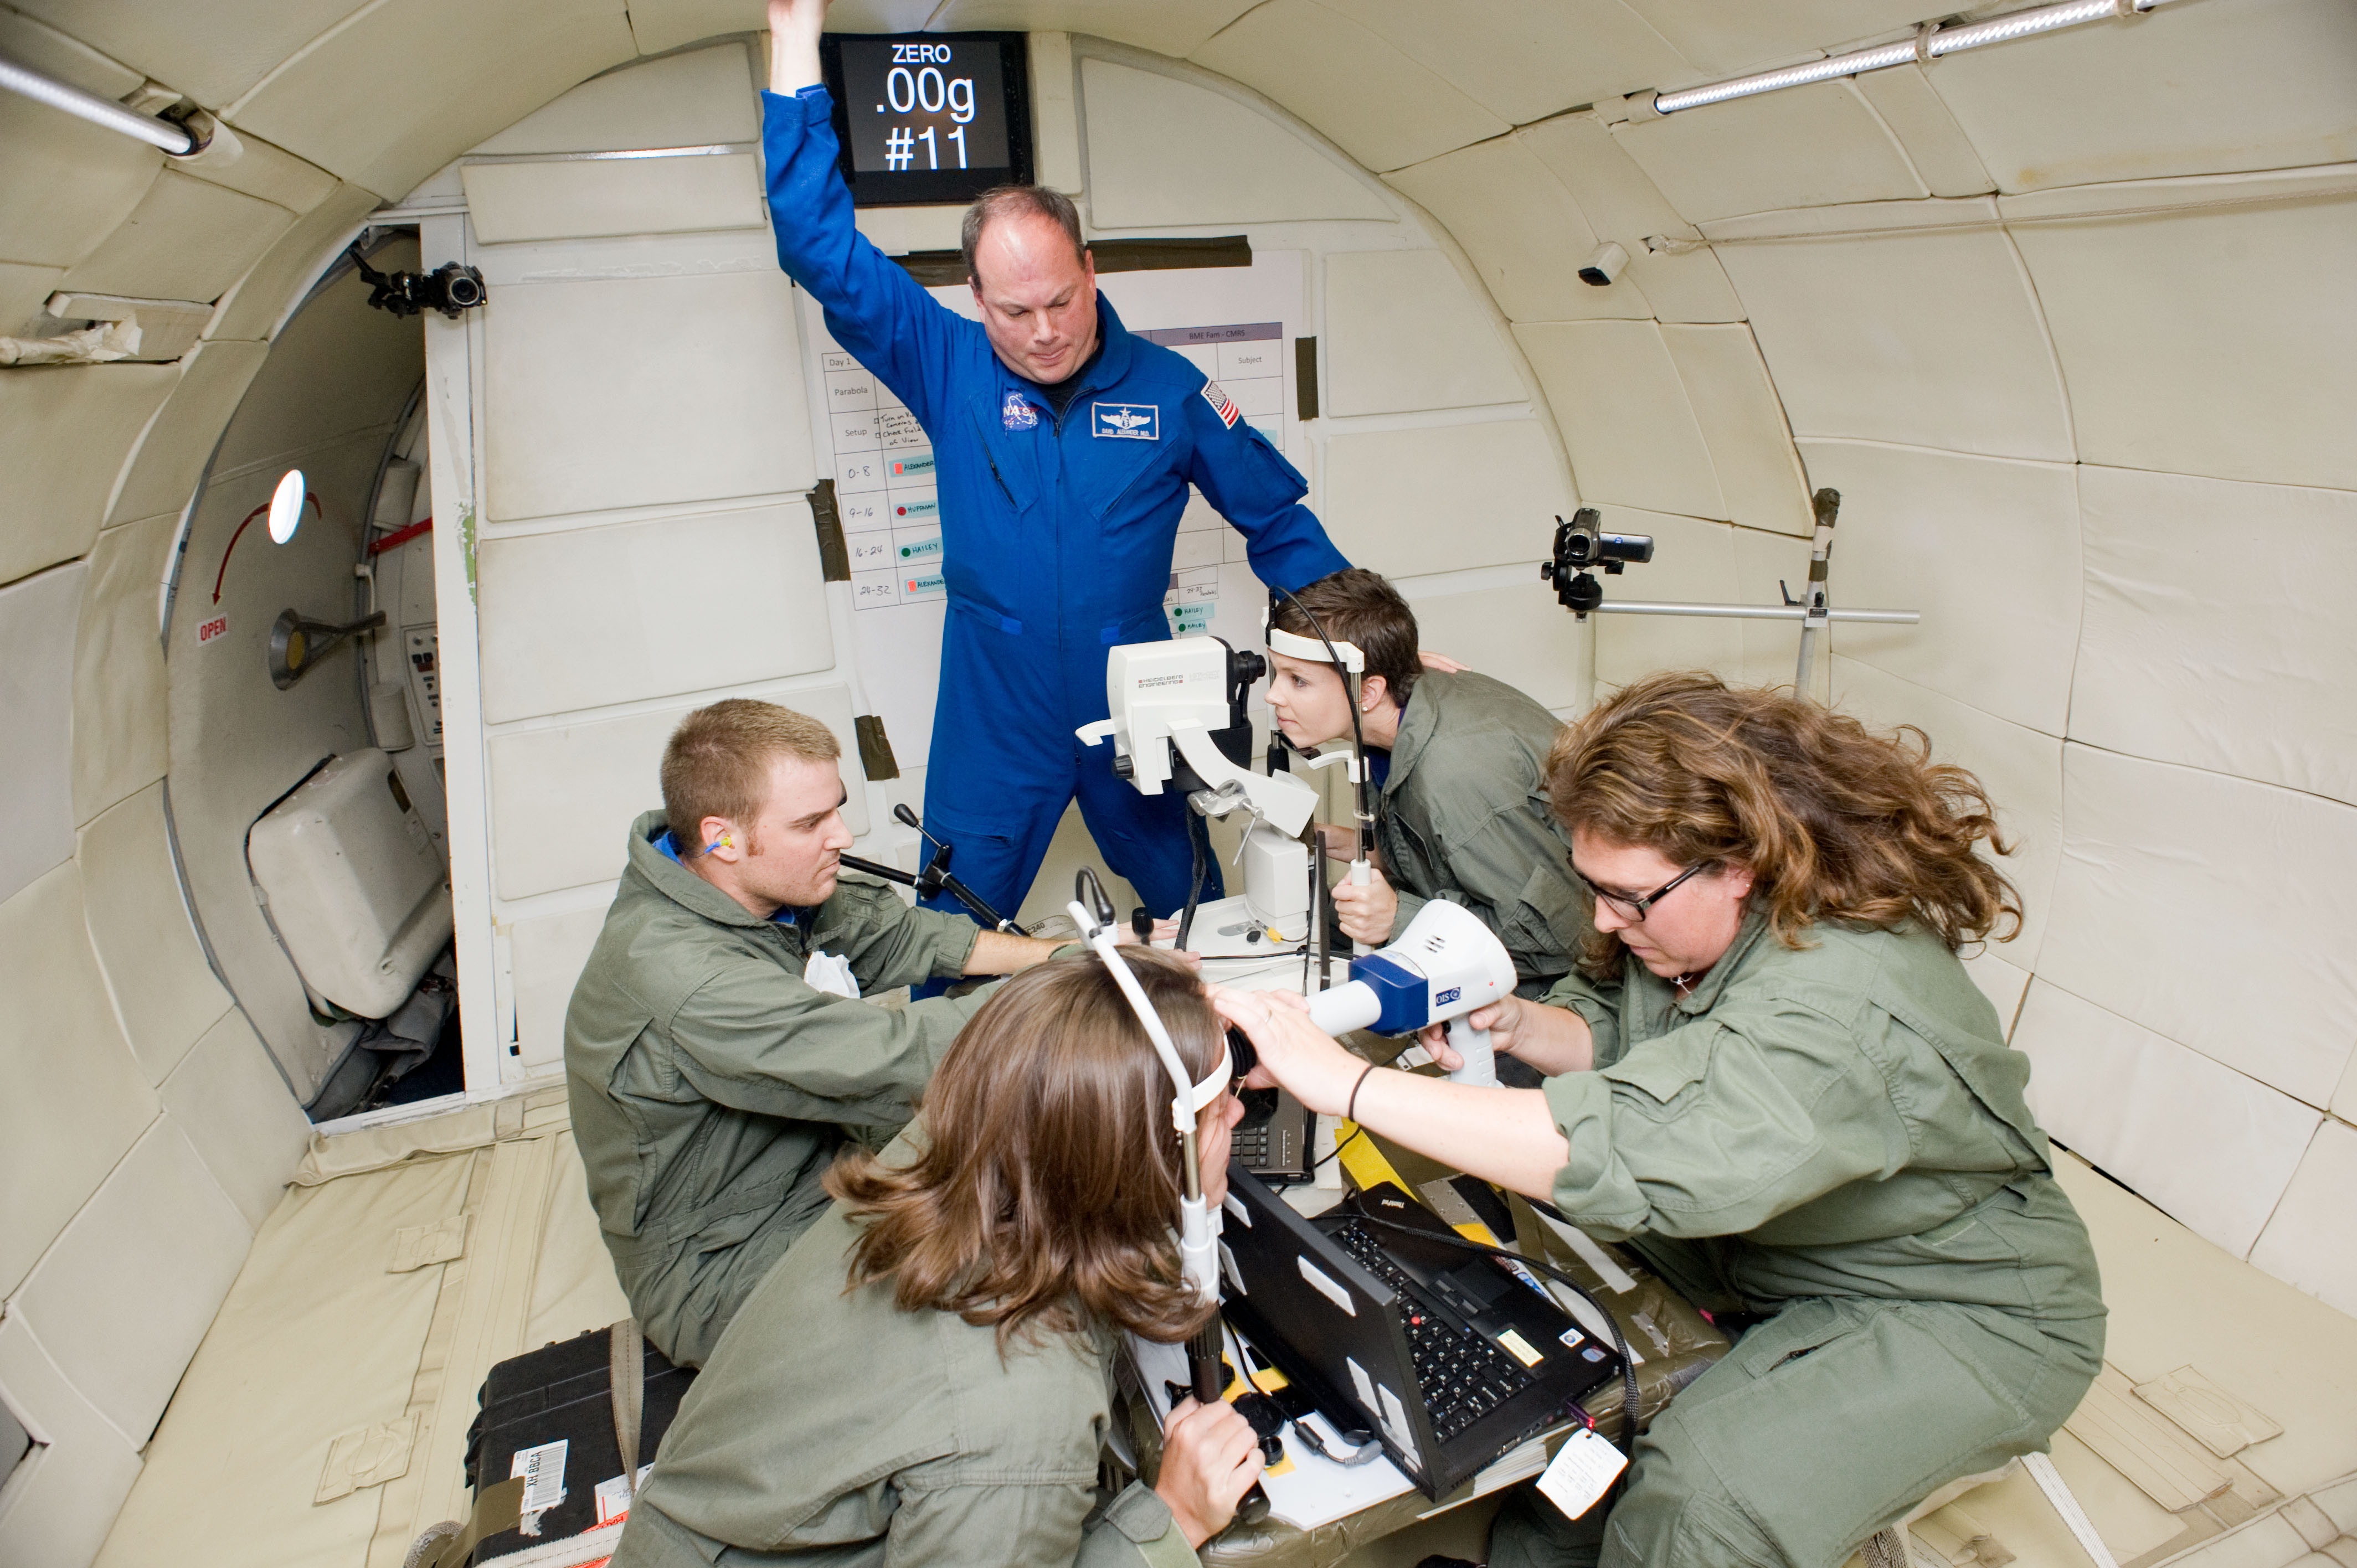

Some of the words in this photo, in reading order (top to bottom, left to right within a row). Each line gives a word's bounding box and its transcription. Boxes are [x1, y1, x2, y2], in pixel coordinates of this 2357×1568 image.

[892, 44, 951, 64] ZERO
[876, 66, 976, 123] .00g
[884, 126, 969, 171] #11
[1238, 356, 1262, 365] Subject
[834, 386, 868, 395] Parabola
[880, 413, 895, 423] Turn
[1003, 405, 1038, 422] NASA
[886, 420, 912, 428] Cameras
[845, 428, 867, 437] Setup
[883, 429, 902, 437] Check
[904, 425, 922, 434] Field
[904, 460, 935, 471] ALEXANDER
[849, 507, 873, 519] 9-16
[855, 545, 883, 558] 16-24
[912, 543, 938, 554] HAILEY
[917, 578, 945, 588] ALEXANDE
[860, 585, 893, 596] 24-32
[1184, 606, 1203, 616] HAILEY
[200, 617, 227, 641] OPEN
[1138, 679, 1179, 688] ENGINEERING
[1143, 674, 1183, 683] HEIDELBERG
[1026, 922, 1046, 935] C240
[1436, 992, 1450, 1004] OIS
[528, 1450, 543, 1474] BBCA
[526, 1473, 539, 1488] XH
